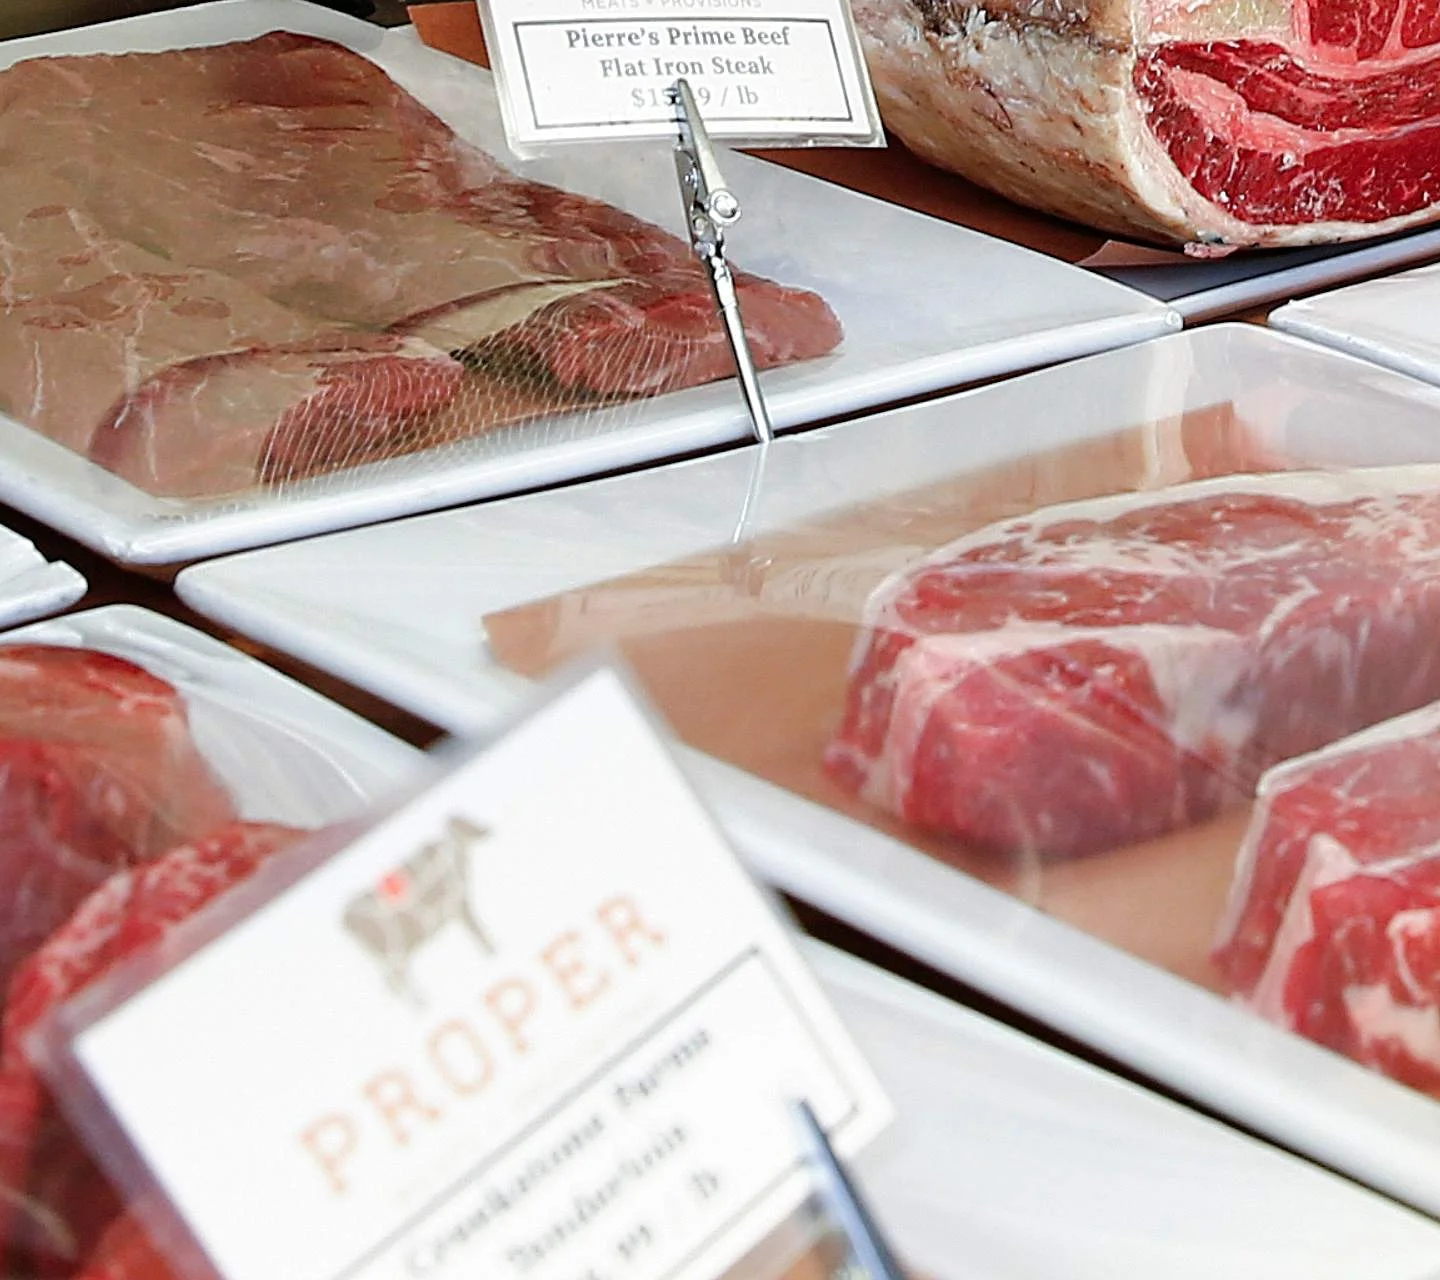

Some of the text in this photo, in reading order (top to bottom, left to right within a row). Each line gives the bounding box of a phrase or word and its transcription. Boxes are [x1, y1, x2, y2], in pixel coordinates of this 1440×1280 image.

[566, 25, 792, 50] Pierre's Prime Beef
[599, 53, 775, 79] Flat Iron Steak
[736, 85, 760, 106] lb
[296, 893, 671, 1198] PROPER
